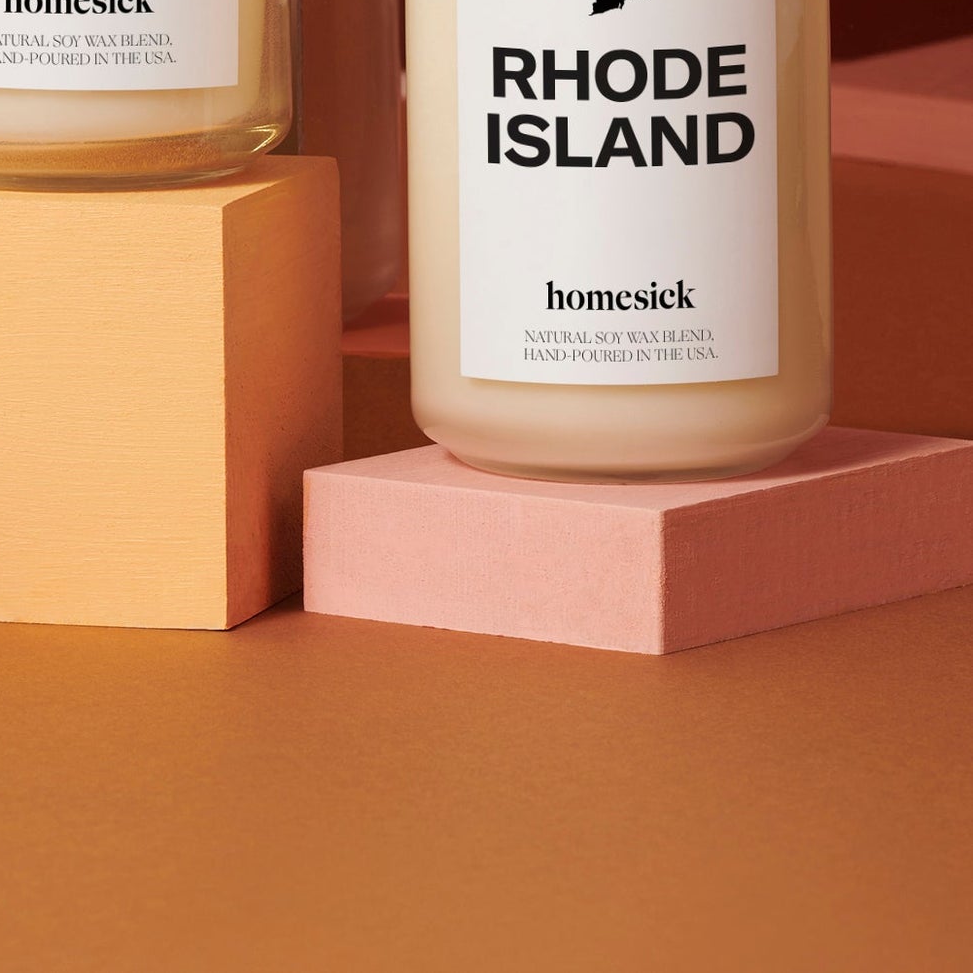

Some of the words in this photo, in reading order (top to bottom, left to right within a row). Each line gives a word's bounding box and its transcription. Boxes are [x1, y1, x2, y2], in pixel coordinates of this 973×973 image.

[52, 34, 81, 48] SOY
[84, 34, 118, 48] WAX
[120, 33, 173, 47] BLEND.
[94, 53, 109, 65] IN
[112, 52, 141, 65] THE
[144, 51, 177, 65] USA.
[492, 43, 748, 103] RHODE
[486, 111, 756, 168] ISLAND
[545, 279, 697, 311] homesick
[524, 329, 592, 344] NATURAL
[595, 331, 623, 344] SOY
[626, 330, 660, 344] WAX
[662, 329, 715, 343] BLEND.
[524, 347, 633, 362] HAND-POURED
[636, 349, 651, 362] IN
[654, 347, 683, 361] THE
[687, 347, 719, 361] USA.
